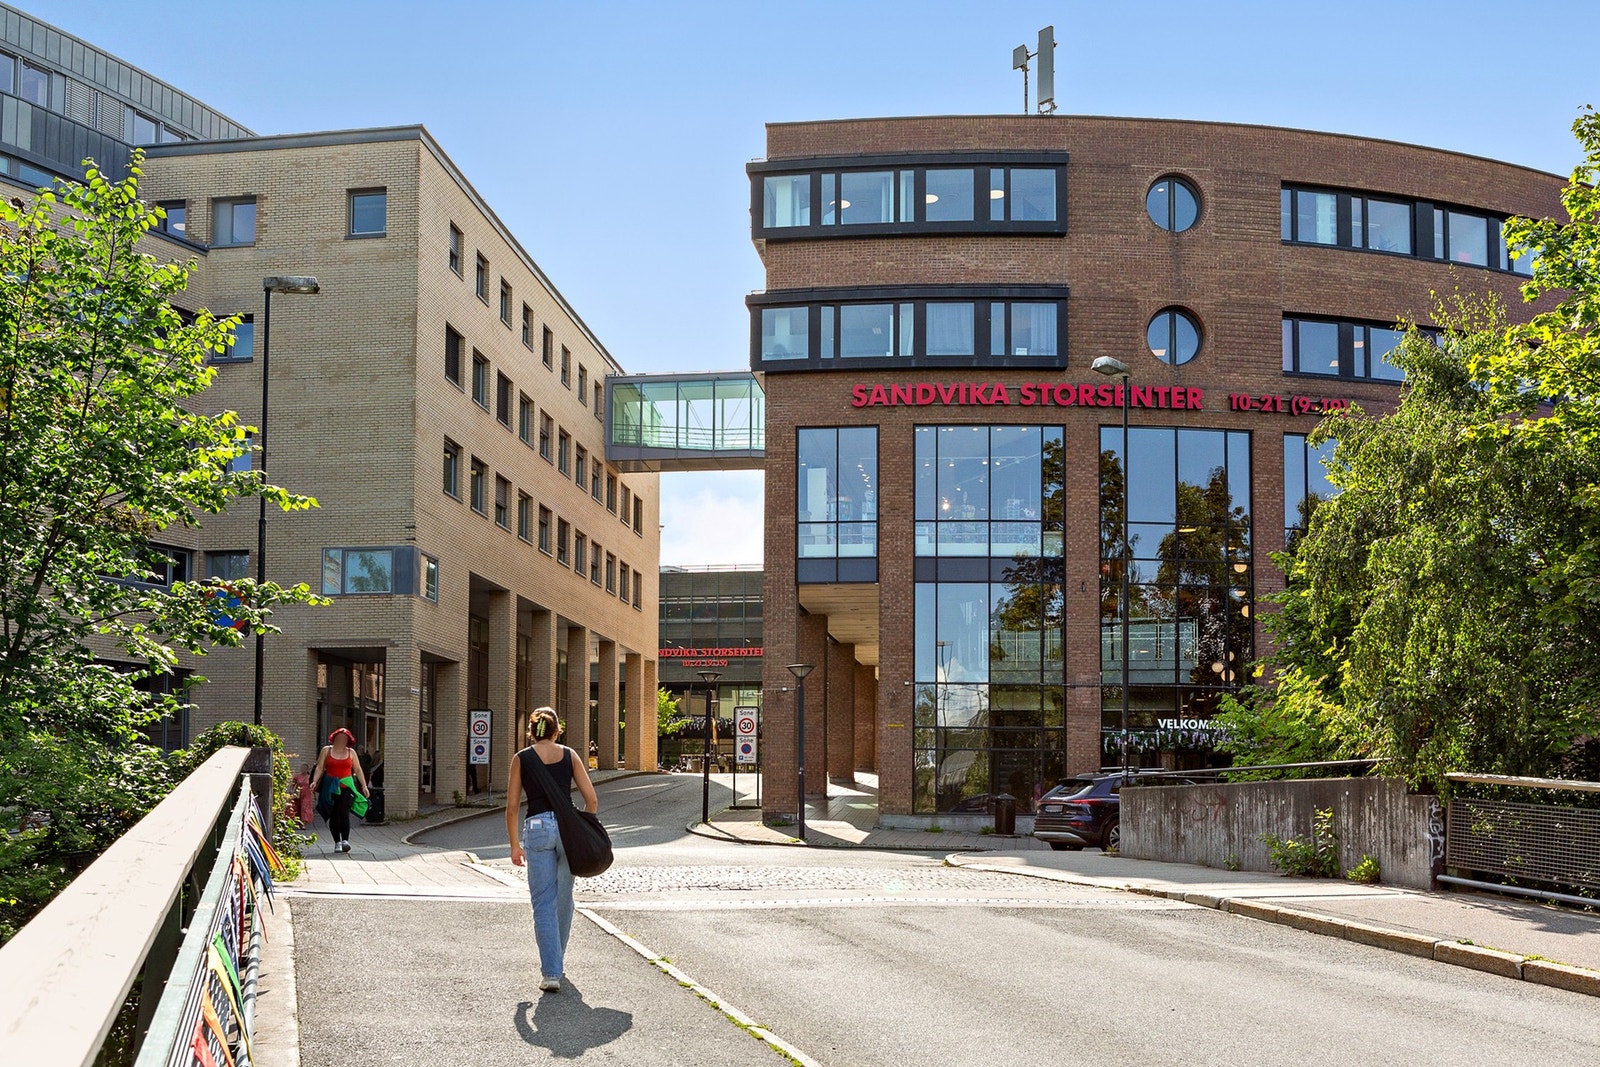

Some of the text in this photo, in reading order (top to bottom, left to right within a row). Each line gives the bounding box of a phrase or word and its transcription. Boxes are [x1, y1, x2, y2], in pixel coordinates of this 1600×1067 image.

[851, 382, 1010, 407] SANDVIKA
[1020, 382, 1203, 409] STORSENTER
[1229, 393, 1282, 412] 10-21
[741, 722, 752, 730] 30
